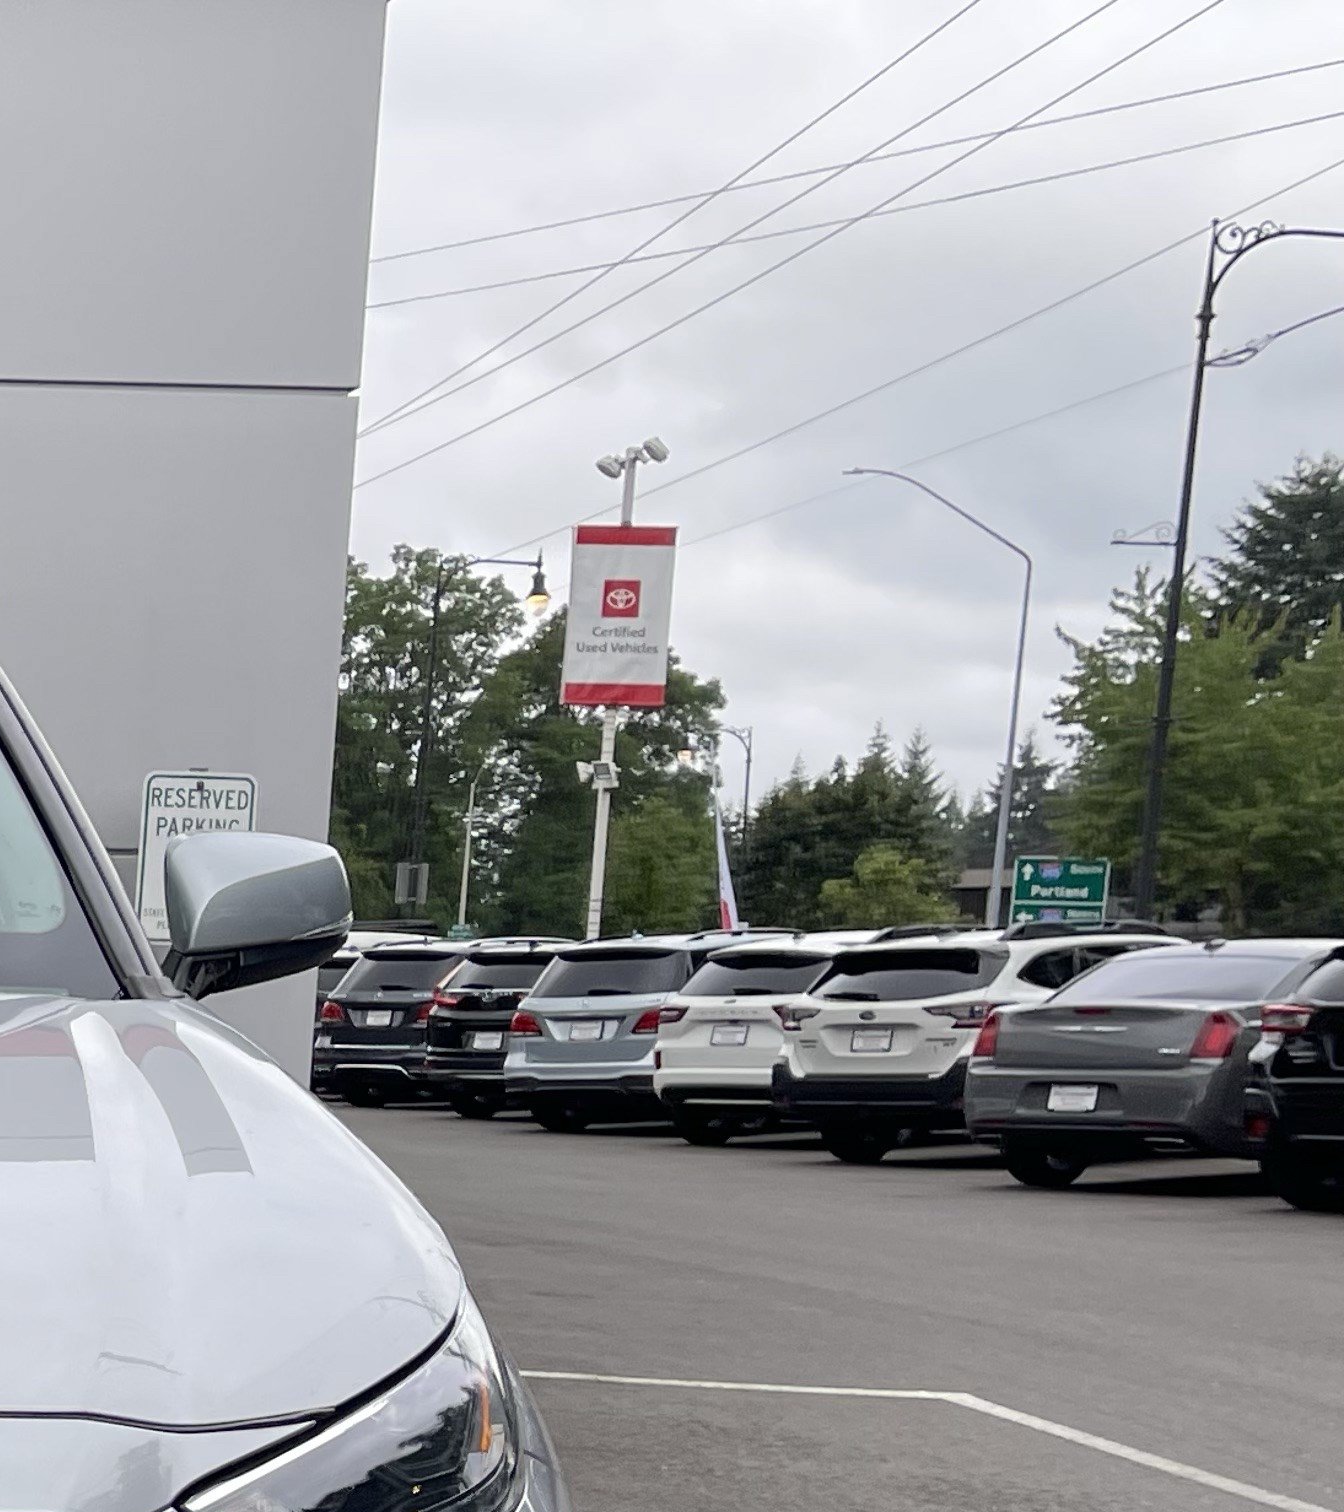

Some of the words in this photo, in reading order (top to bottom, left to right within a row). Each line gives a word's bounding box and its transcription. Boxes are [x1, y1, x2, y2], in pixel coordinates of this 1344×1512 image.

[592, 626, 646, 638] Certified
[576, 642, 608, 653] Used
[611, 642, 659, 654] Vehicles
[151, 787, 249, 810] RESERVED
[1030, 884, 1089, 899] Portland
